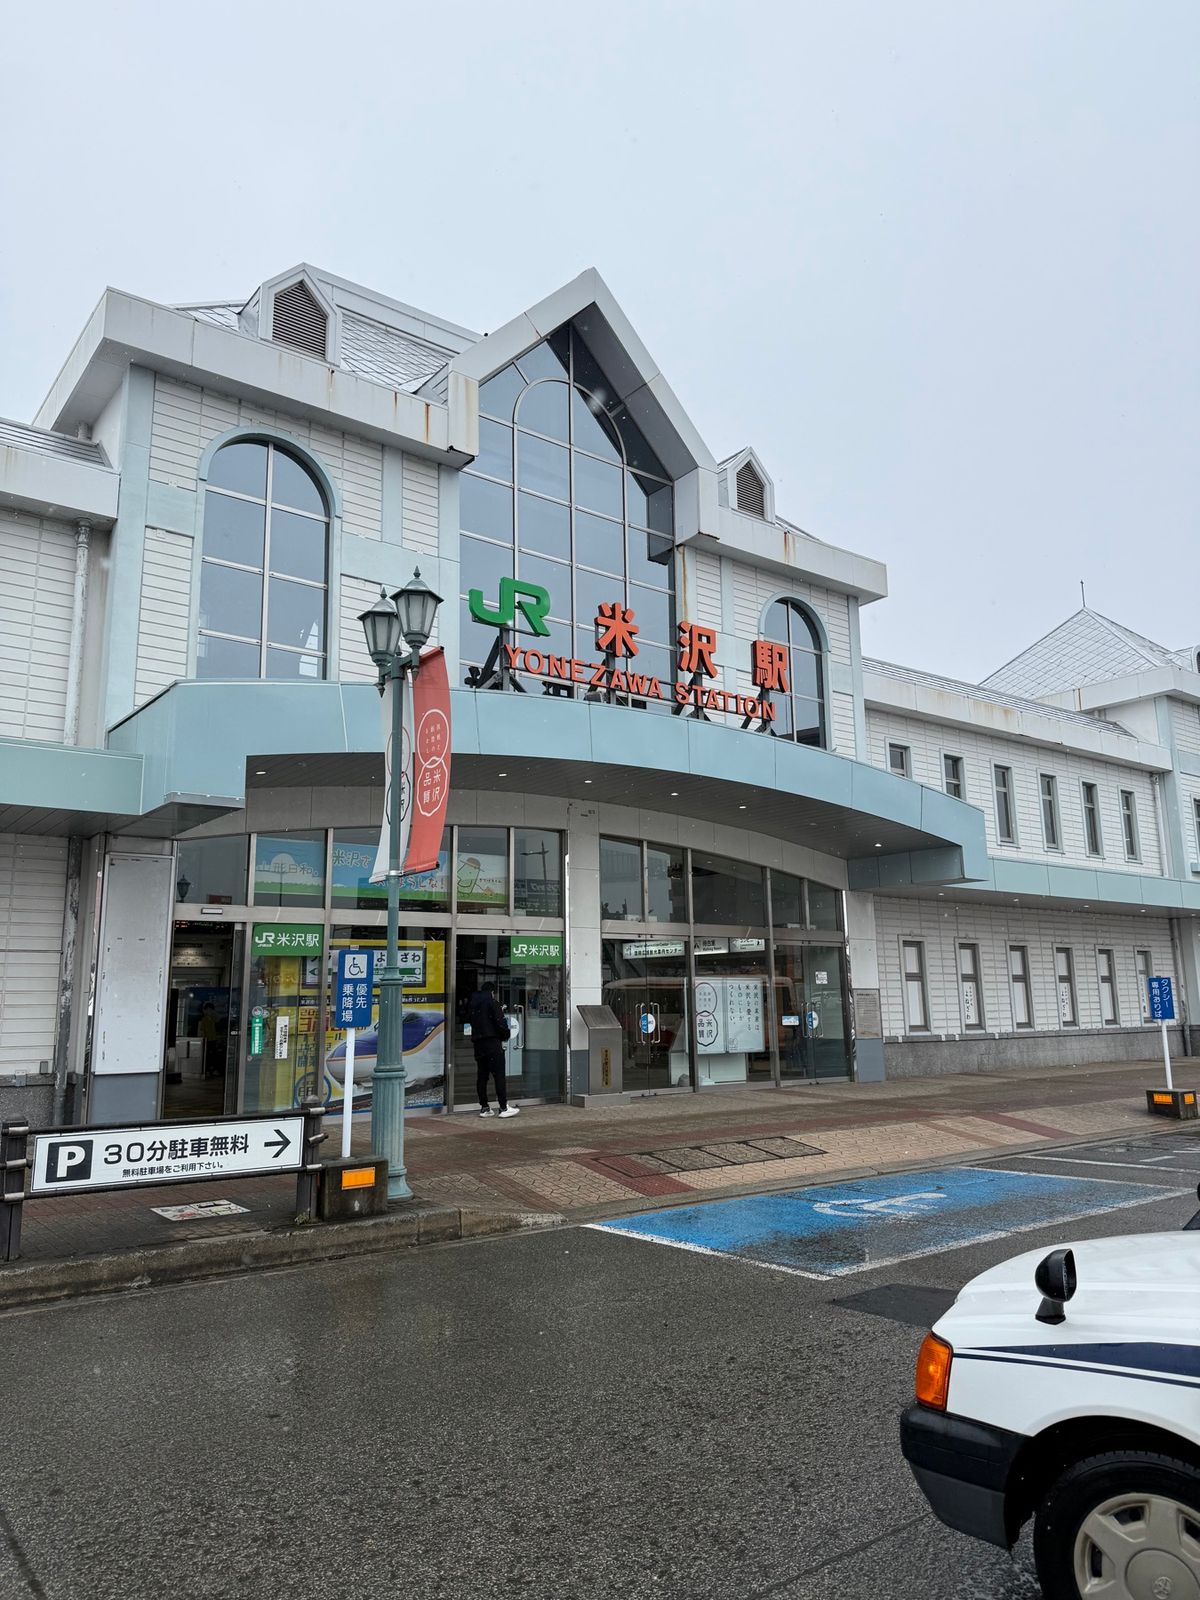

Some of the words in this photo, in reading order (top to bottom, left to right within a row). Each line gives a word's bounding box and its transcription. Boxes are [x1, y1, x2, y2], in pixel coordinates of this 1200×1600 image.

[469, 577, 551, 637] JR
[594, 602, 789, 693] 米沢駅
[504, 644, 664, 700] YONEZAWA
[674, 682, 776, 722] STATION
[432, 768, 441, 802] 米沢
[277, 932, 319, 947] 米沢駅
[529, 944, 560, 957] 米沢駅
[376, 951, 421, 963] よざわ
[341, 983, 354, 1023] 乗降場
[355, 983, 368, 1008] 優先
[1151, 982, 1162, 1018] 専用おりば
[1161, 978, 1170, 1008] タクシー
[56, 1145, 86, 1178] P
[103, 1133, 249, 1165] 30分駐車無料
[122, 1161, 224, 1178] 無料駐車場をご利用下さい。
